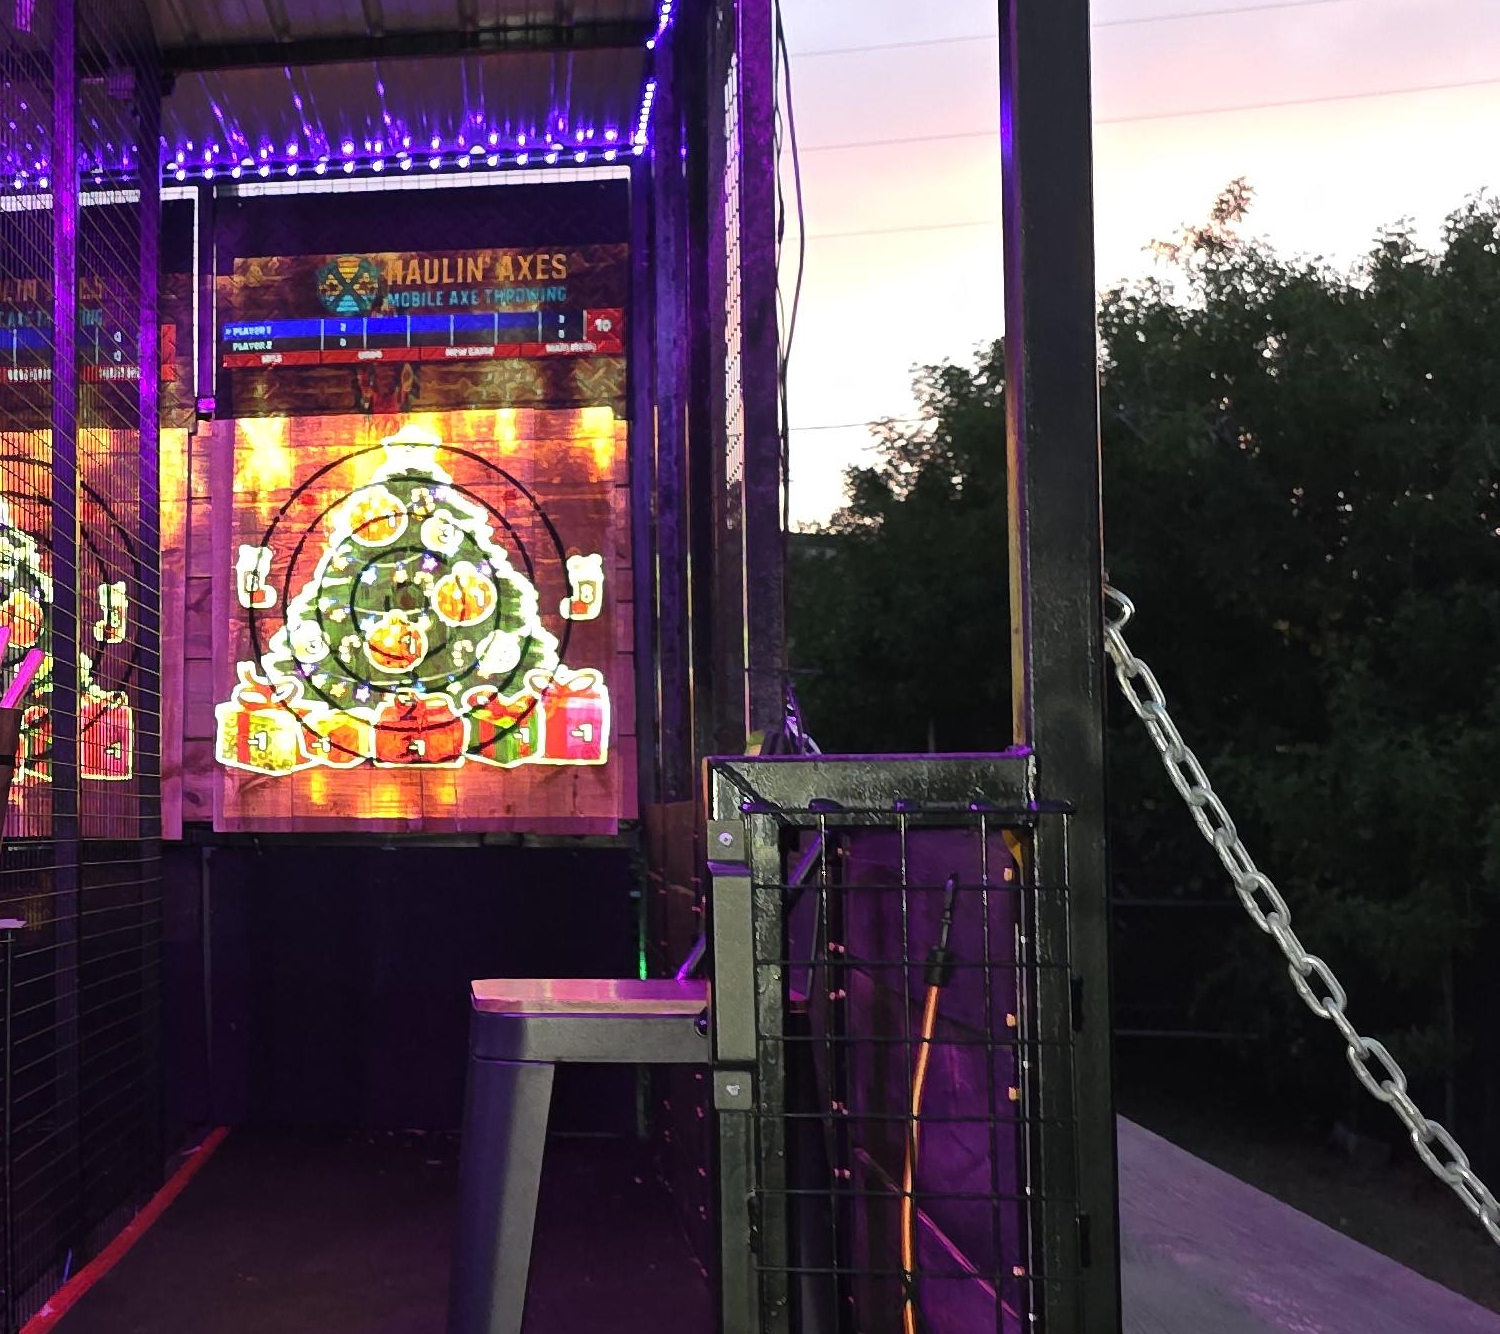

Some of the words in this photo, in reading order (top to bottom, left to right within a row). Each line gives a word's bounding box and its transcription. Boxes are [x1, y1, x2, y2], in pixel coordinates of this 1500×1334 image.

[386, 255, 491, 285] HAULIN'
[497, 253, 569, 283] AXES
[388, 289, 444, 308] MOBILE
[449, 288, 479, 306] AXE
[483, 284, 568, 306] THROWING
